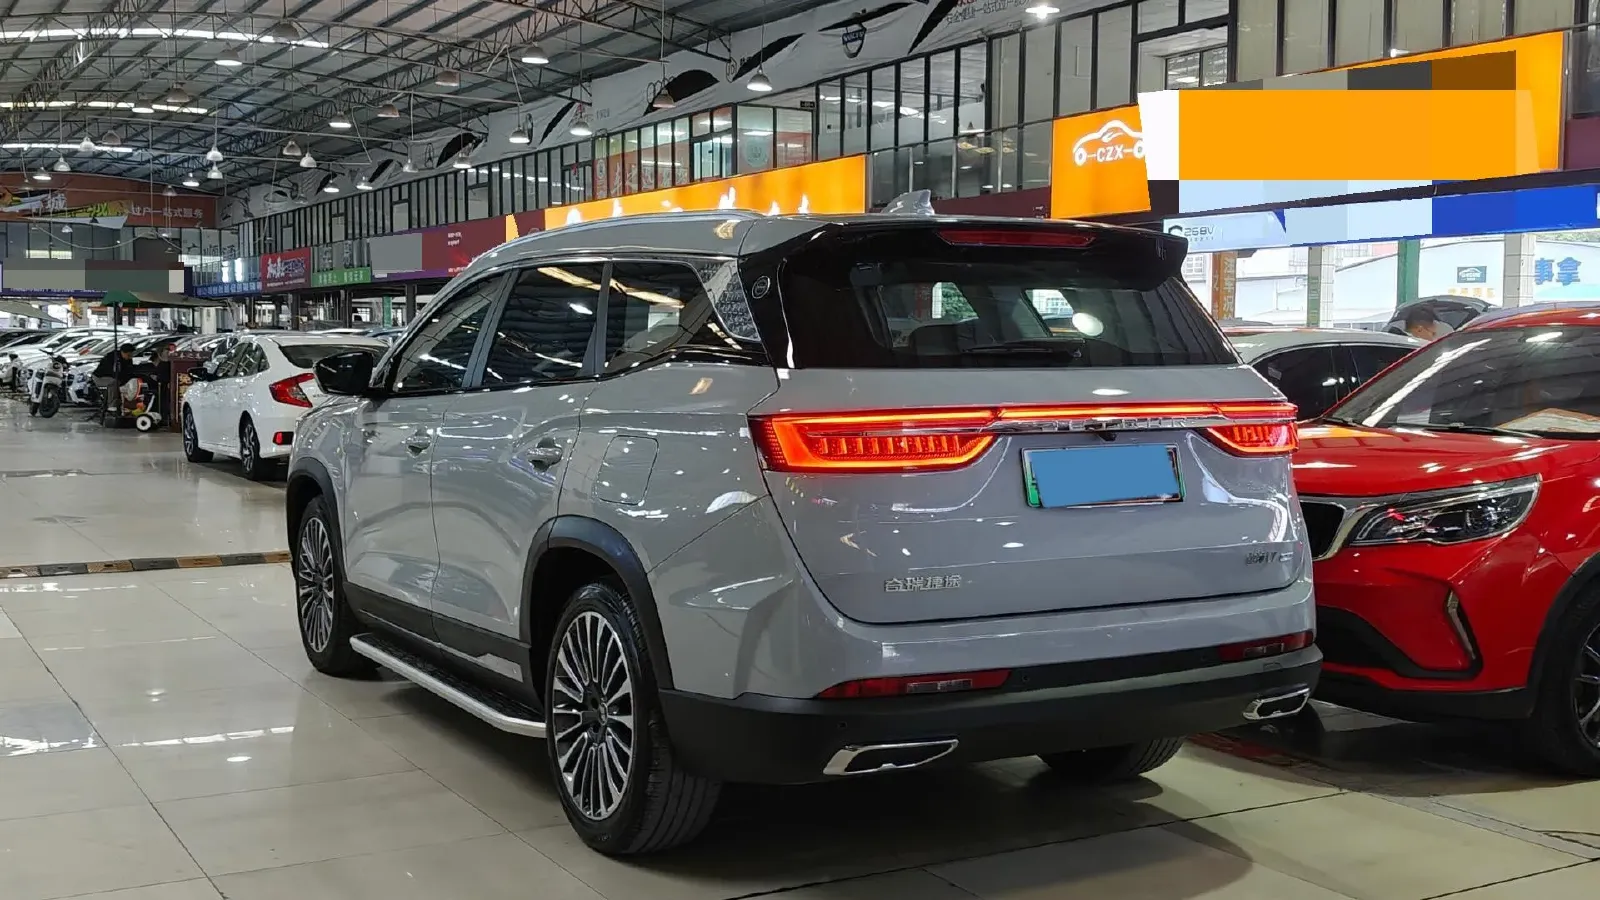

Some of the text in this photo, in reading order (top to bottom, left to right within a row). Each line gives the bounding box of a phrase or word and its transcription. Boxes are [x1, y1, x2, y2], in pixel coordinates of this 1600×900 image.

[1096, 144, 1124, 162] CZX
[884, 574, 962, 592] 奇瑞捷途
